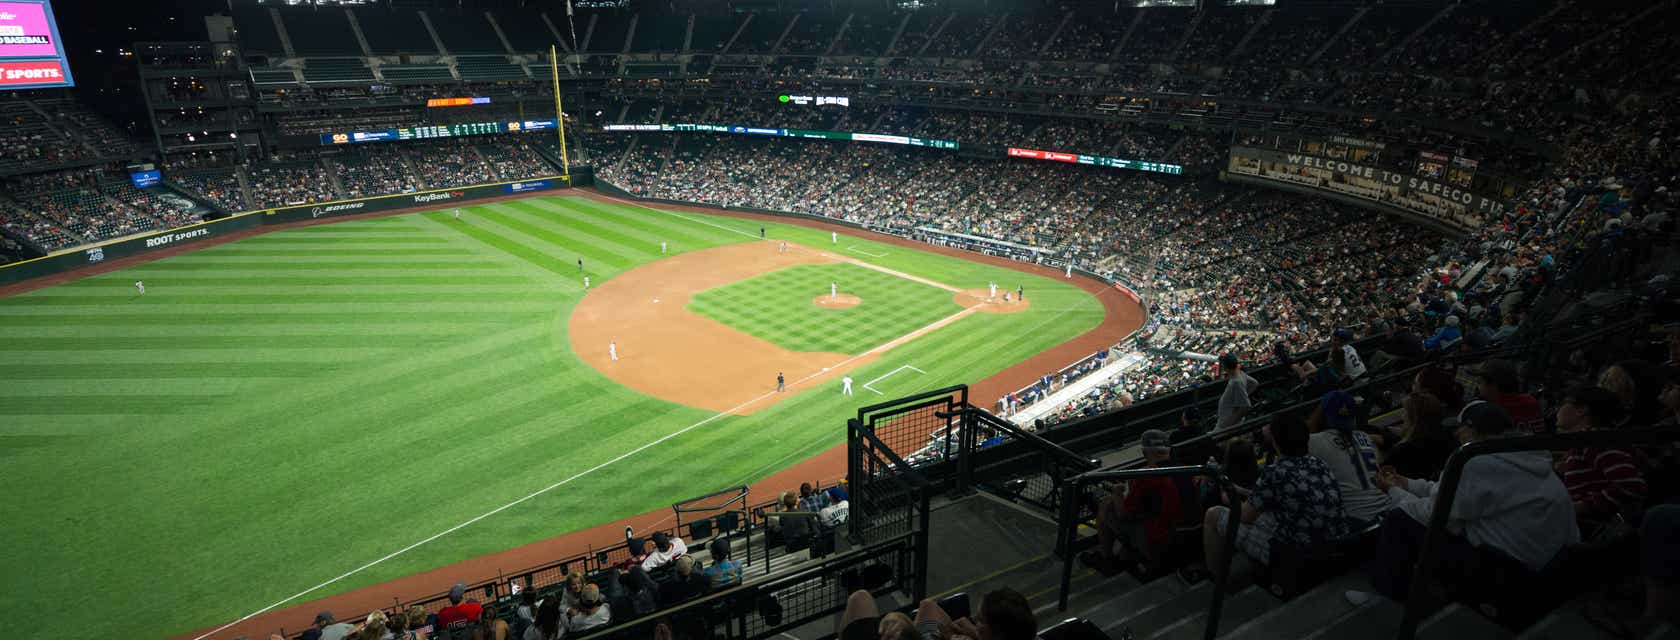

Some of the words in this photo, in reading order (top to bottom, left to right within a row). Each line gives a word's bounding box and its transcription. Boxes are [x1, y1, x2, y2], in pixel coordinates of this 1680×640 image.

[6, 69, 59, 79] SPORTS
[1288, 155, 1374, 178] WELCOME
[1383, 171, 1401, 184] TO
[1409, 178, 1473, 204] SAFECO
[414, 193, 451, 203] KeyBank
[325, 202, 365, 212] BOEING
[146, 234, 174, 247] ROOT
[175, 229, 207, 241] SPORTS
